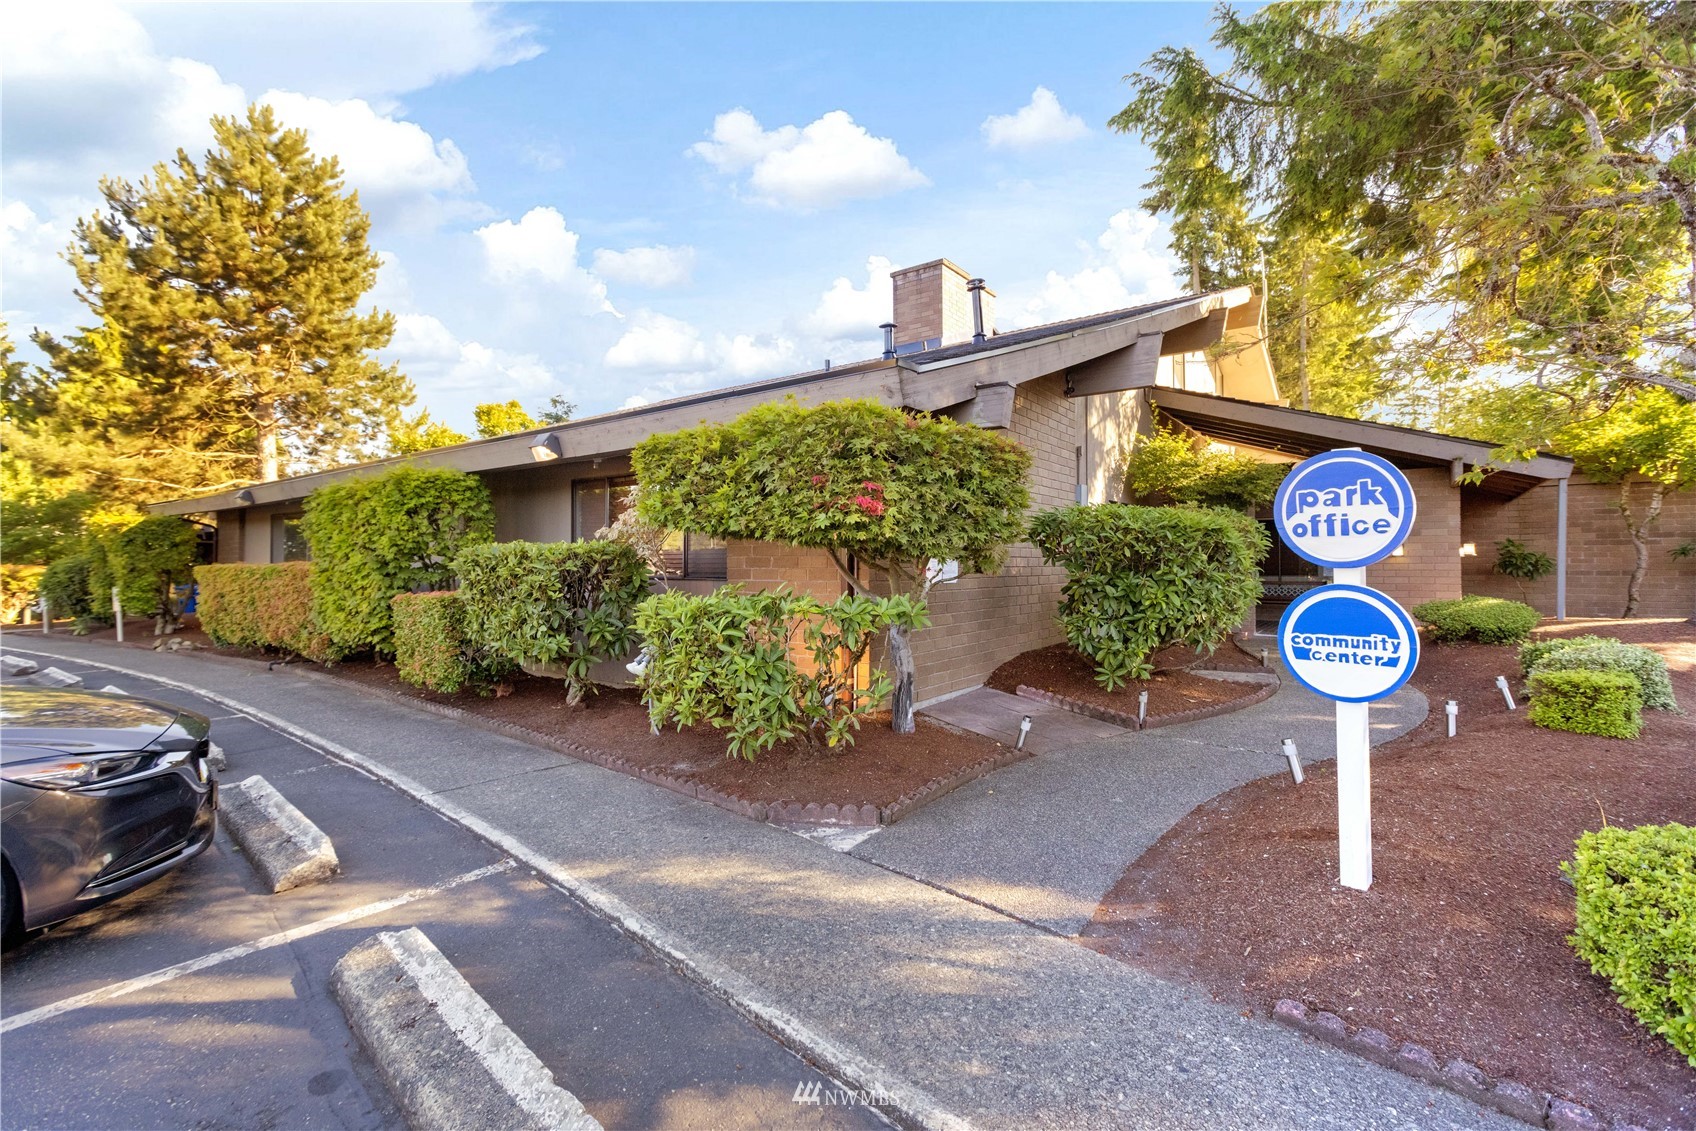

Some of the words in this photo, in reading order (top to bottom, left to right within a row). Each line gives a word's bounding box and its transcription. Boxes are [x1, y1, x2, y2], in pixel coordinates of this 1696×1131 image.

[1297, 480, 1384, 513] park
[1292, 513, 1391, 537] office
[1291, 633, 1401, 653] community
[1311, 650, 1383, 667] center
